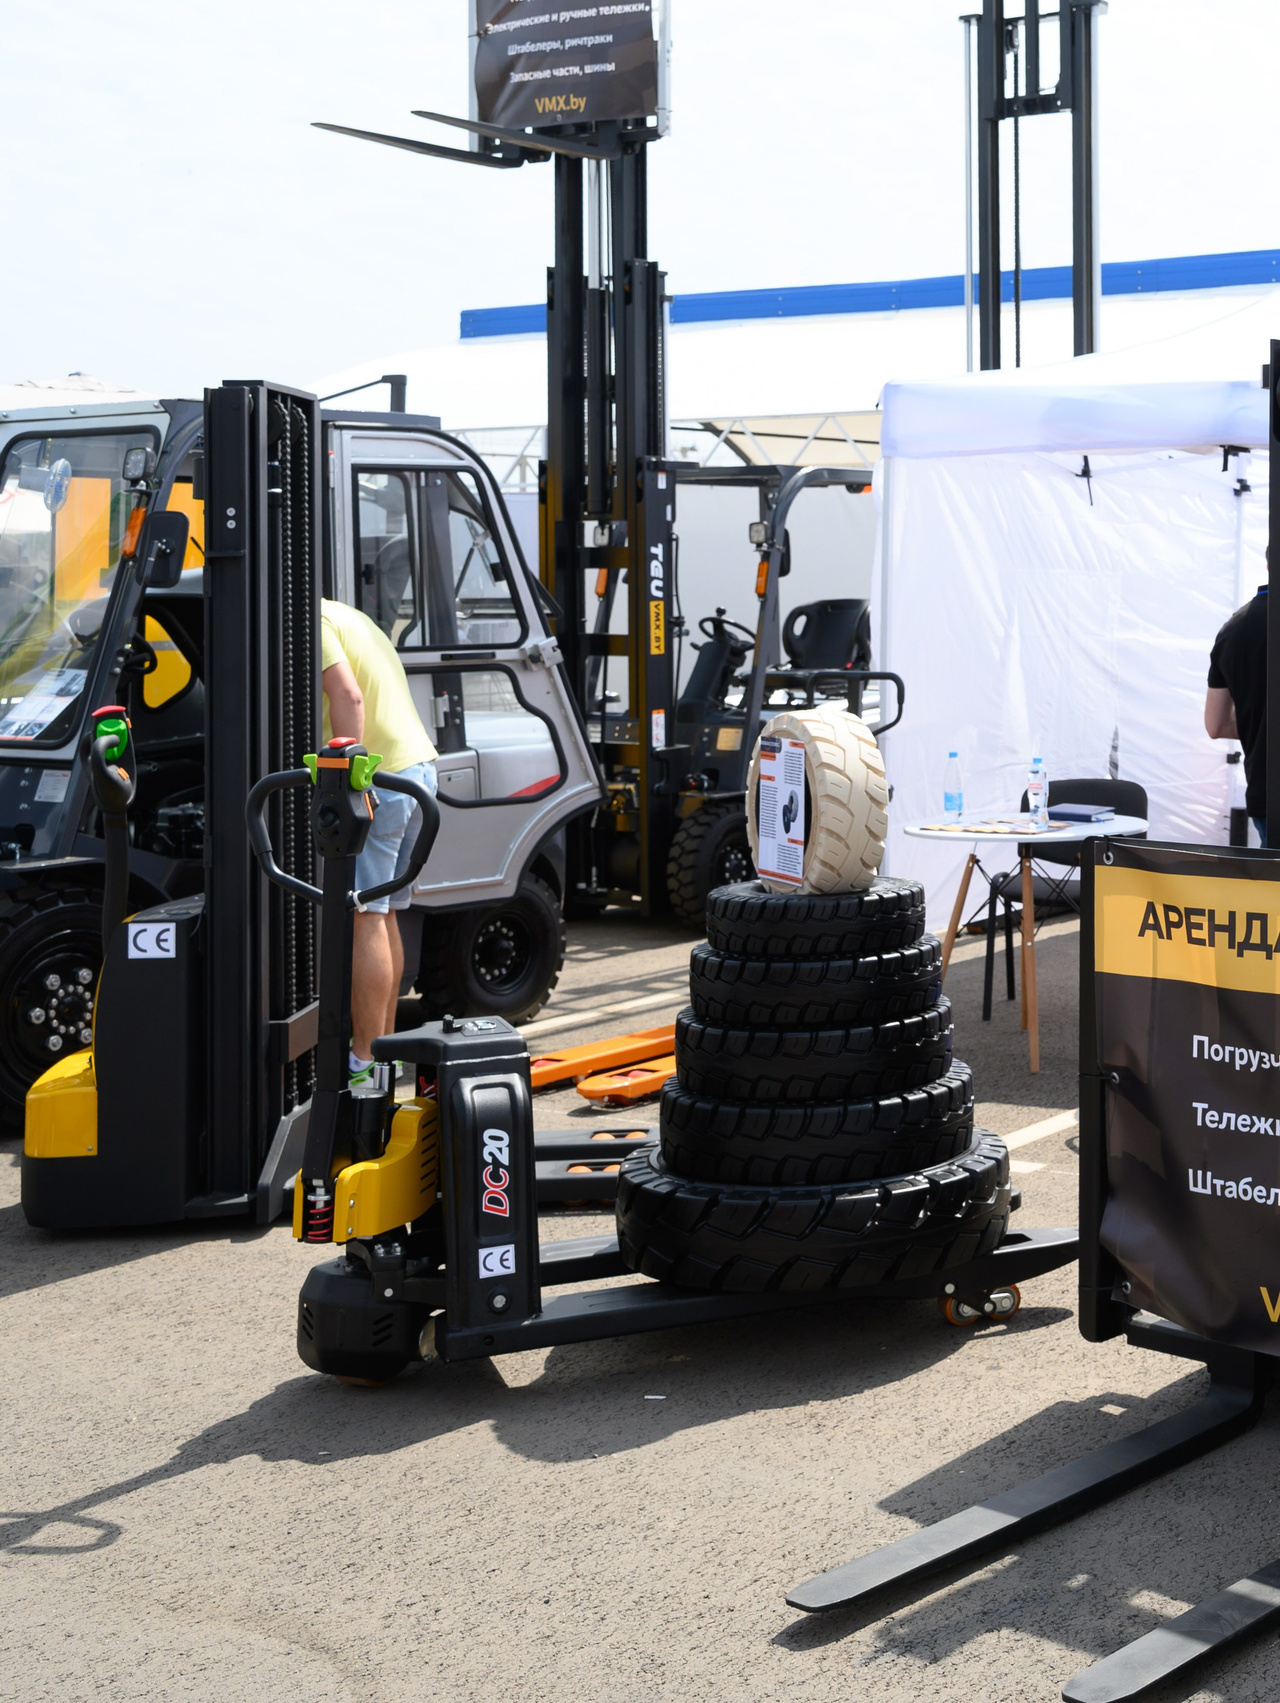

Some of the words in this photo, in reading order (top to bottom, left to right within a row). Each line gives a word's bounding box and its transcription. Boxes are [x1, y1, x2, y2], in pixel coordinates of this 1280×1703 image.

[485, 13, 551, 35] Электрические
[551, 13, 558, 21] и
[560, 8, 597, 23] ручные
[507, 39, 563, 56] Штабелеры,
[565, 34, 613, 50] ричтраки
[510, 69, 552, 84] Запасные
[552, 65, 583, 78] части,
[584, 62, 616, 74] шины
[535, 94, 587, 114] VMX.by
[653, 603, 662, 651] VMX.BY
[132, 927, 171, 953] CE
[482, 1128, 510, 1218] DC20
[482, 1249, 511, 1273] CE
